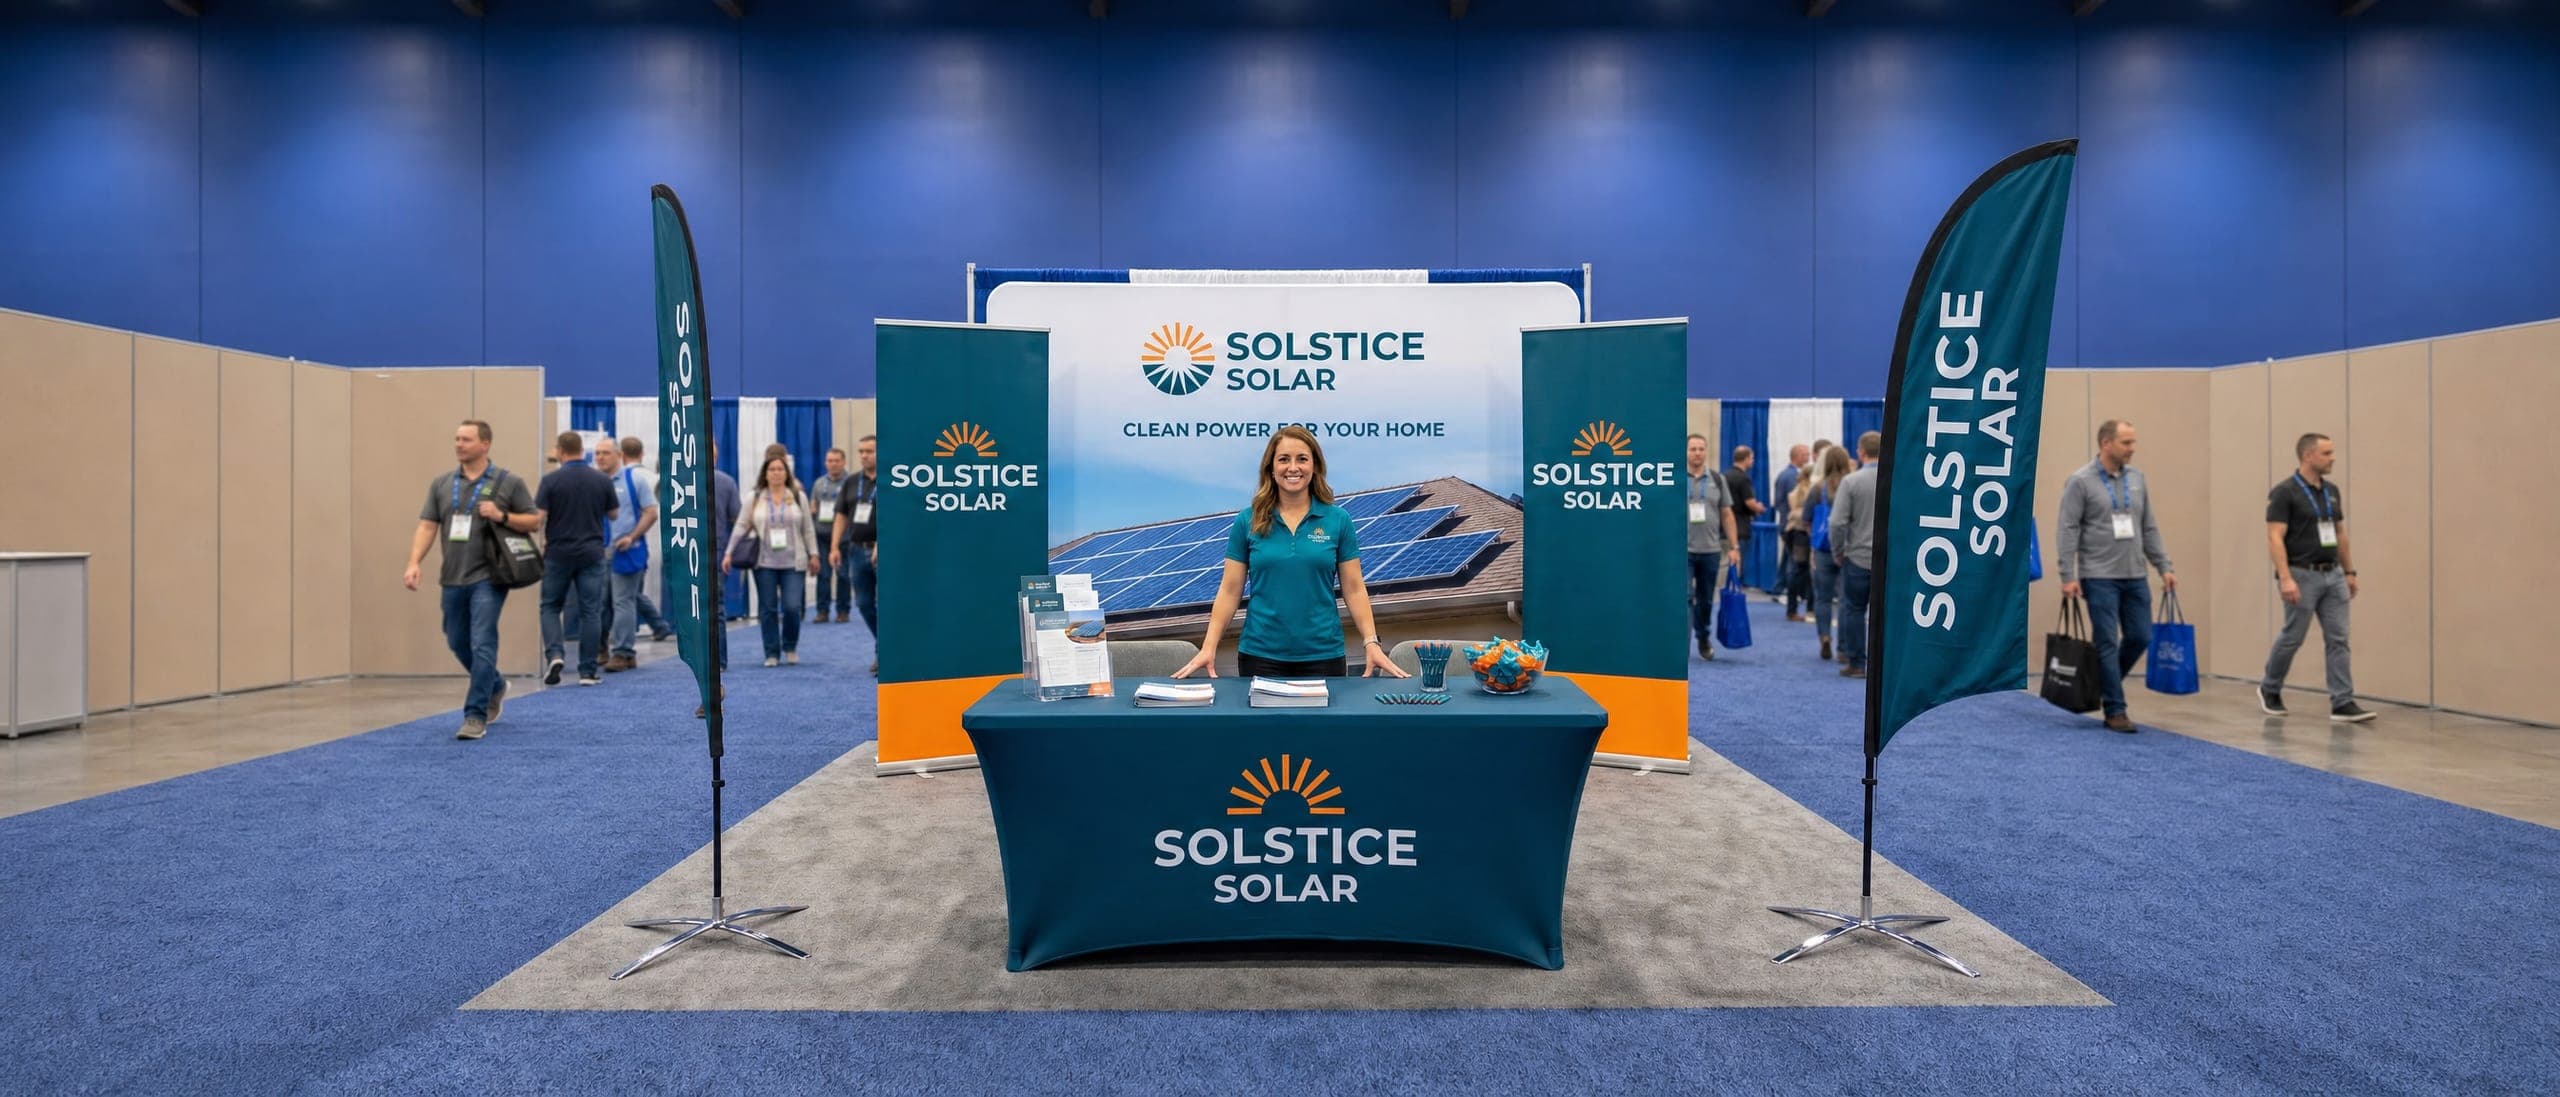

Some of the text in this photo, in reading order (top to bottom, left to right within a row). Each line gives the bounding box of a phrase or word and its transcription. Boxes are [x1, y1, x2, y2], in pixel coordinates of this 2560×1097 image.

[1226, 332, 1425, 361] SOLSTICE
[1226, 368, 1336, 391] SOLAR
[1123, 422, 1445, 438] CLEAN POWER FR YOUR HOME
[669, 381, 688, 548] SOLAR
[1913, 291, 1984, 631] SOLSTICE
[1969, 367, 2019, 557] SOLAR
[891, 464, 1038, 488] SOLSTICE
[1532, 463, 1675, 486] SOLSTICE
[925, 493, 1007, 511] SOLAR
[1563, 491, 1642, 510] SOLAR
[1154, 827, 1417, 867] SOLSTICE
[1214, 874, 1358, 903] SOLAR
